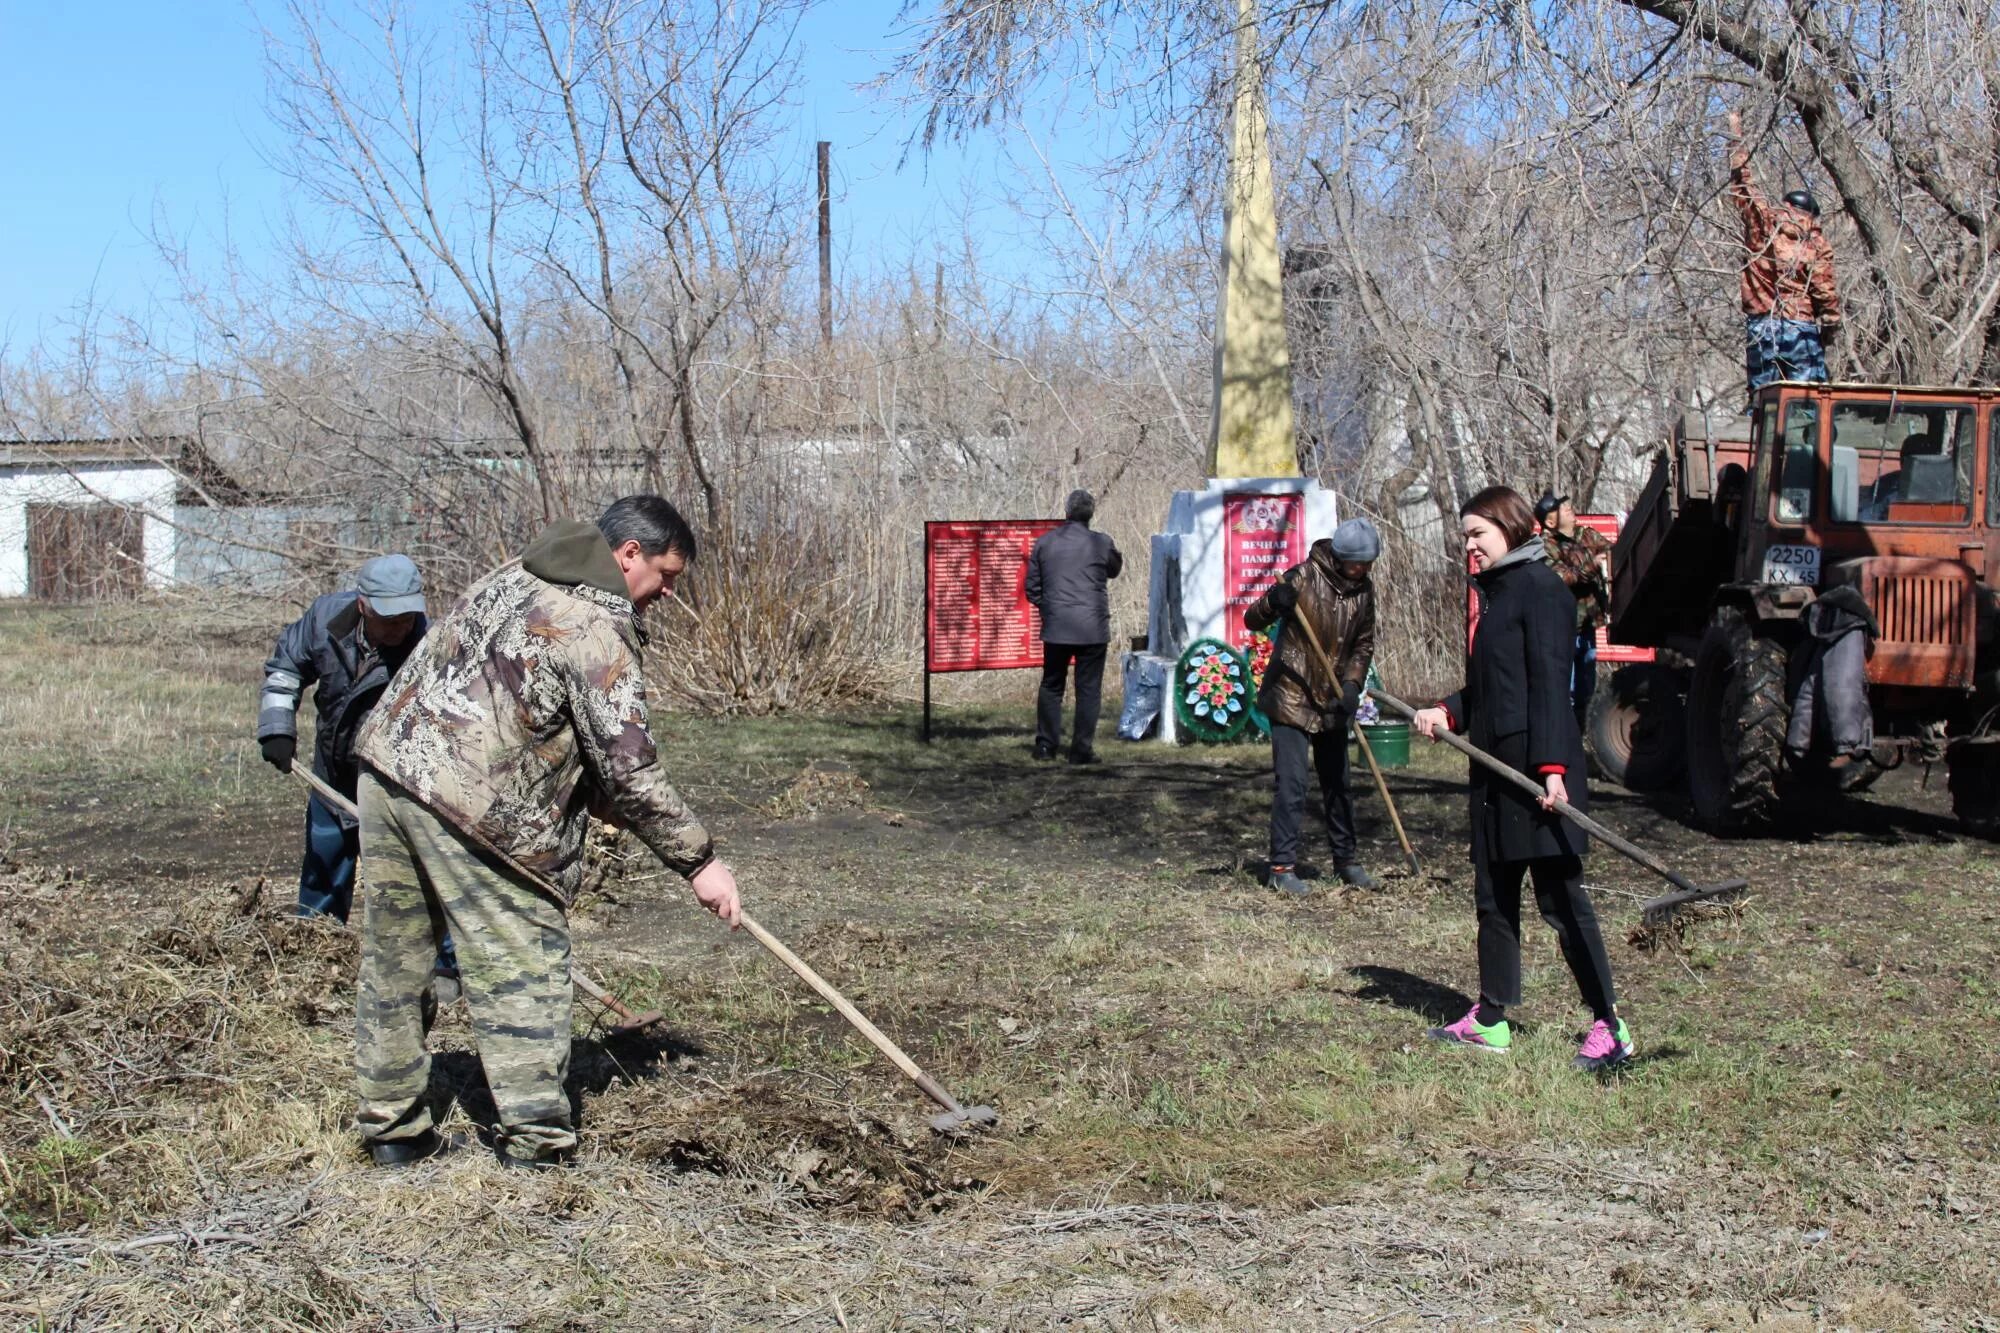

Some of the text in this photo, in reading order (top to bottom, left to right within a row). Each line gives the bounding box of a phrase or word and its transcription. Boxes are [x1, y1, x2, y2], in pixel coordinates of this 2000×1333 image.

[1241, 541, 1288, 550] ВЕЧНАЯ
[1241, 554, 1289, 564] ПАМЯТЬ
[1772, 548, 1814, 565] 2250
[1799, 571, 1816, 583] 45
